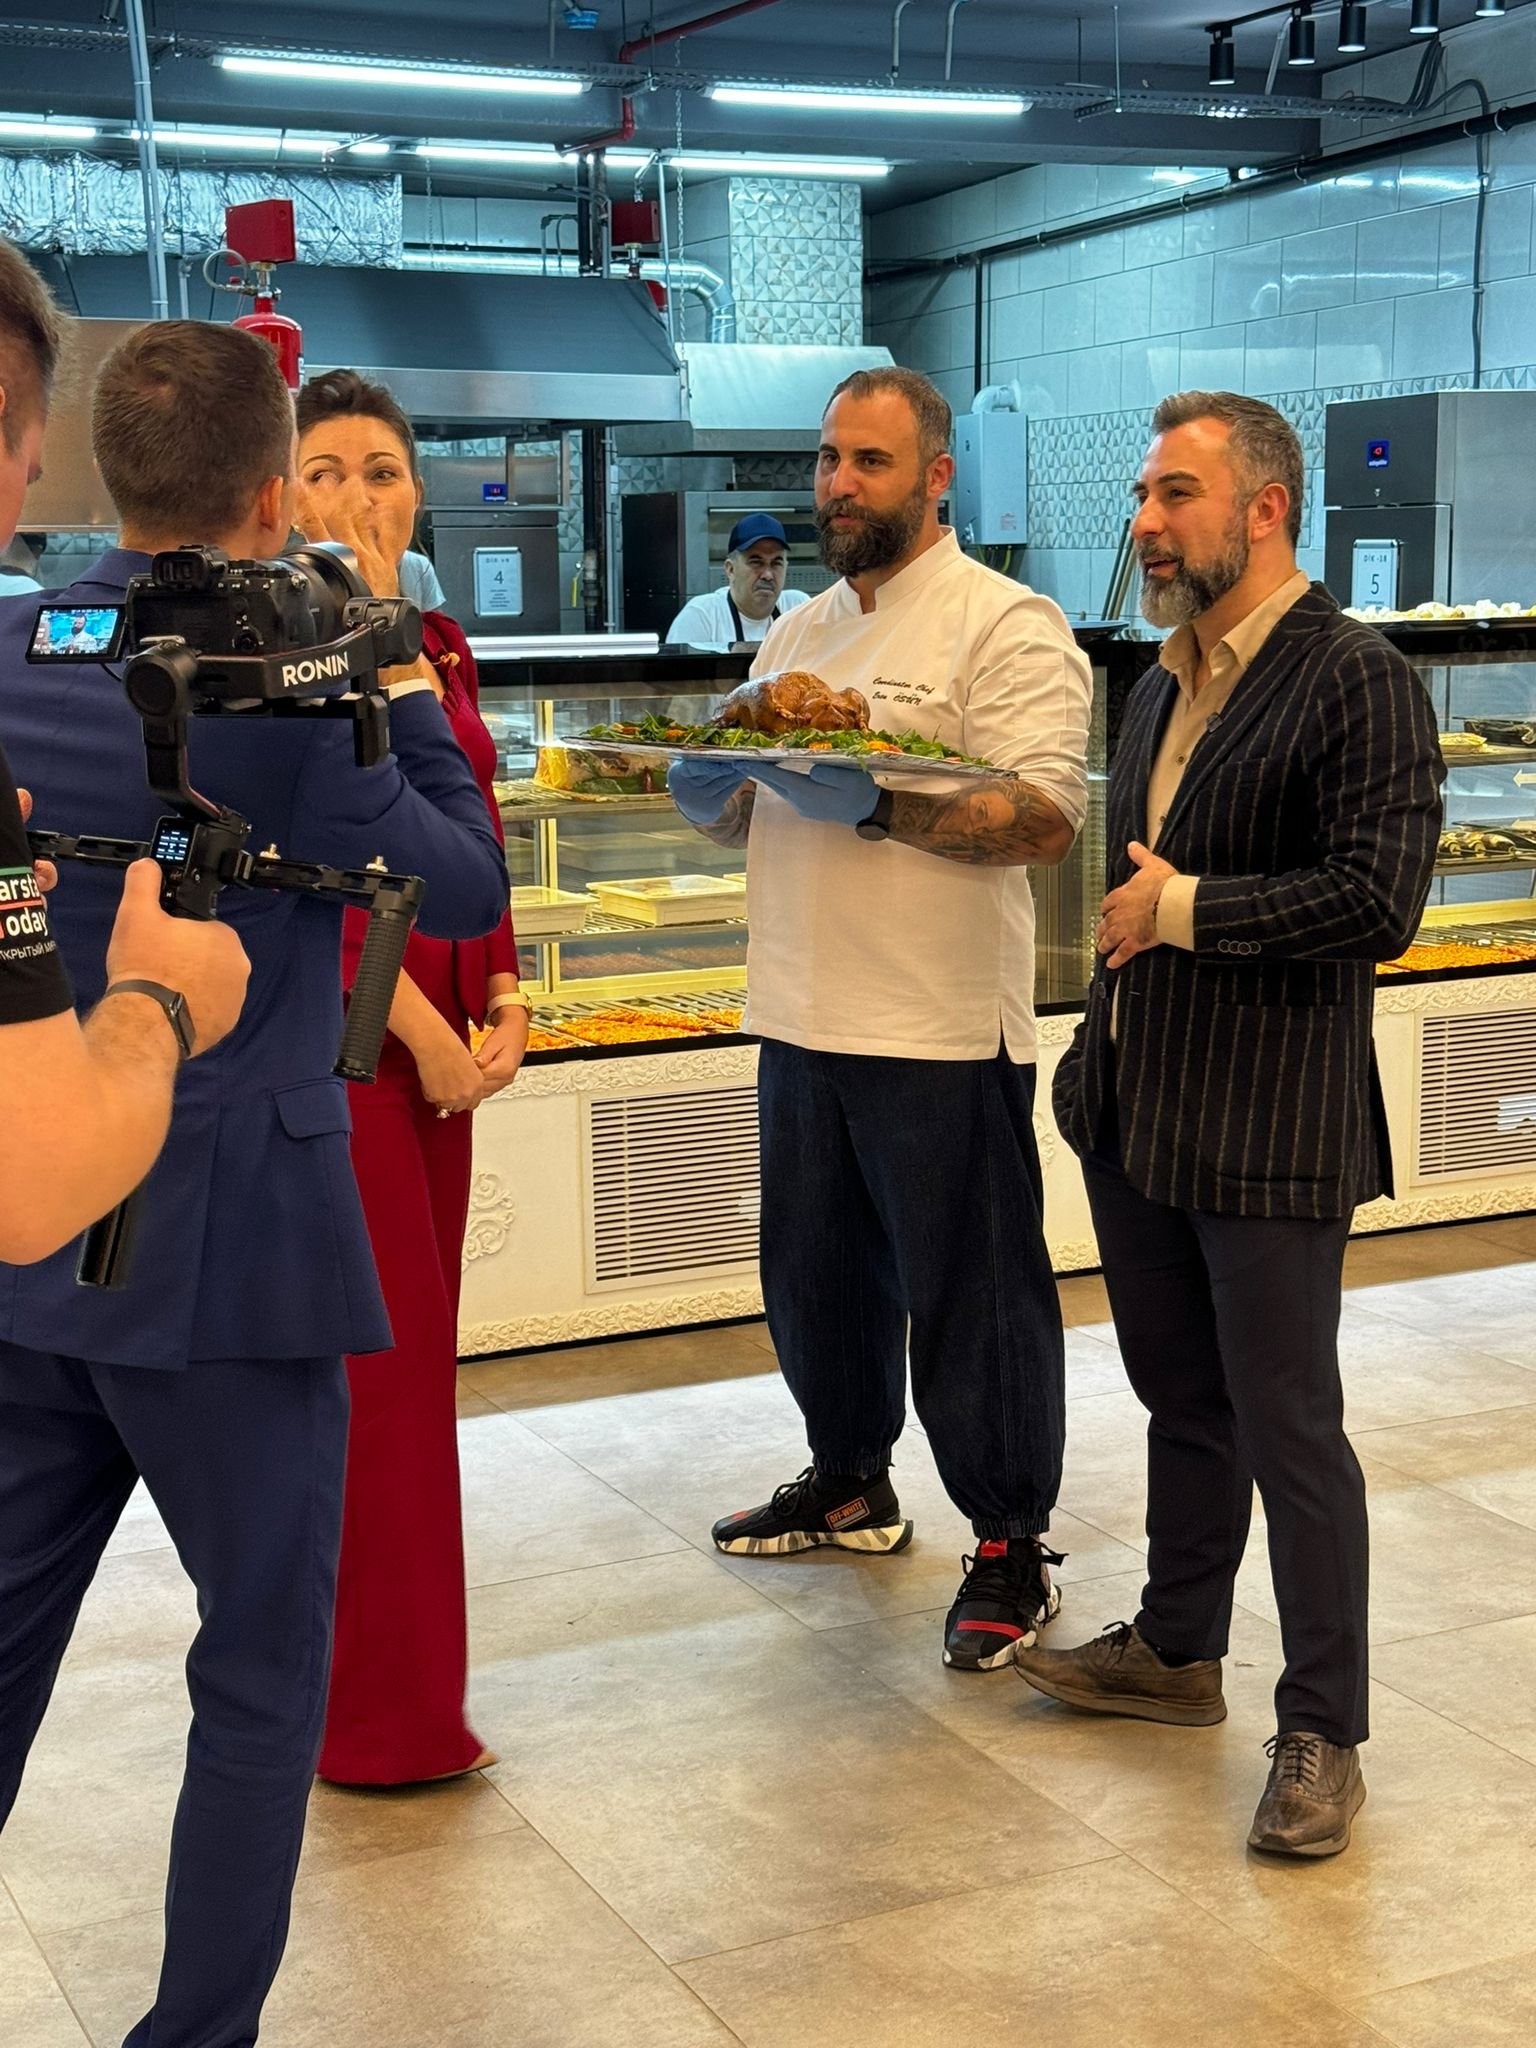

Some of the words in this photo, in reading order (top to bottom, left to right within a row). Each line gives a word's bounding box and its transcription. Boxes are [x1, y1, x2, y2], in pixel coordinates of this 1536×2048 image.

[493, 570, 505, 585] 4
[1370, 573, 1380, 595] 5
[281, 651, 349, 688] RONIN
[0, 906, 48, 939] oday
[0, 942, 45, 961] ТКРЫТЫЙ
[829, 1500, 864, 1523] OFF-WHITE
